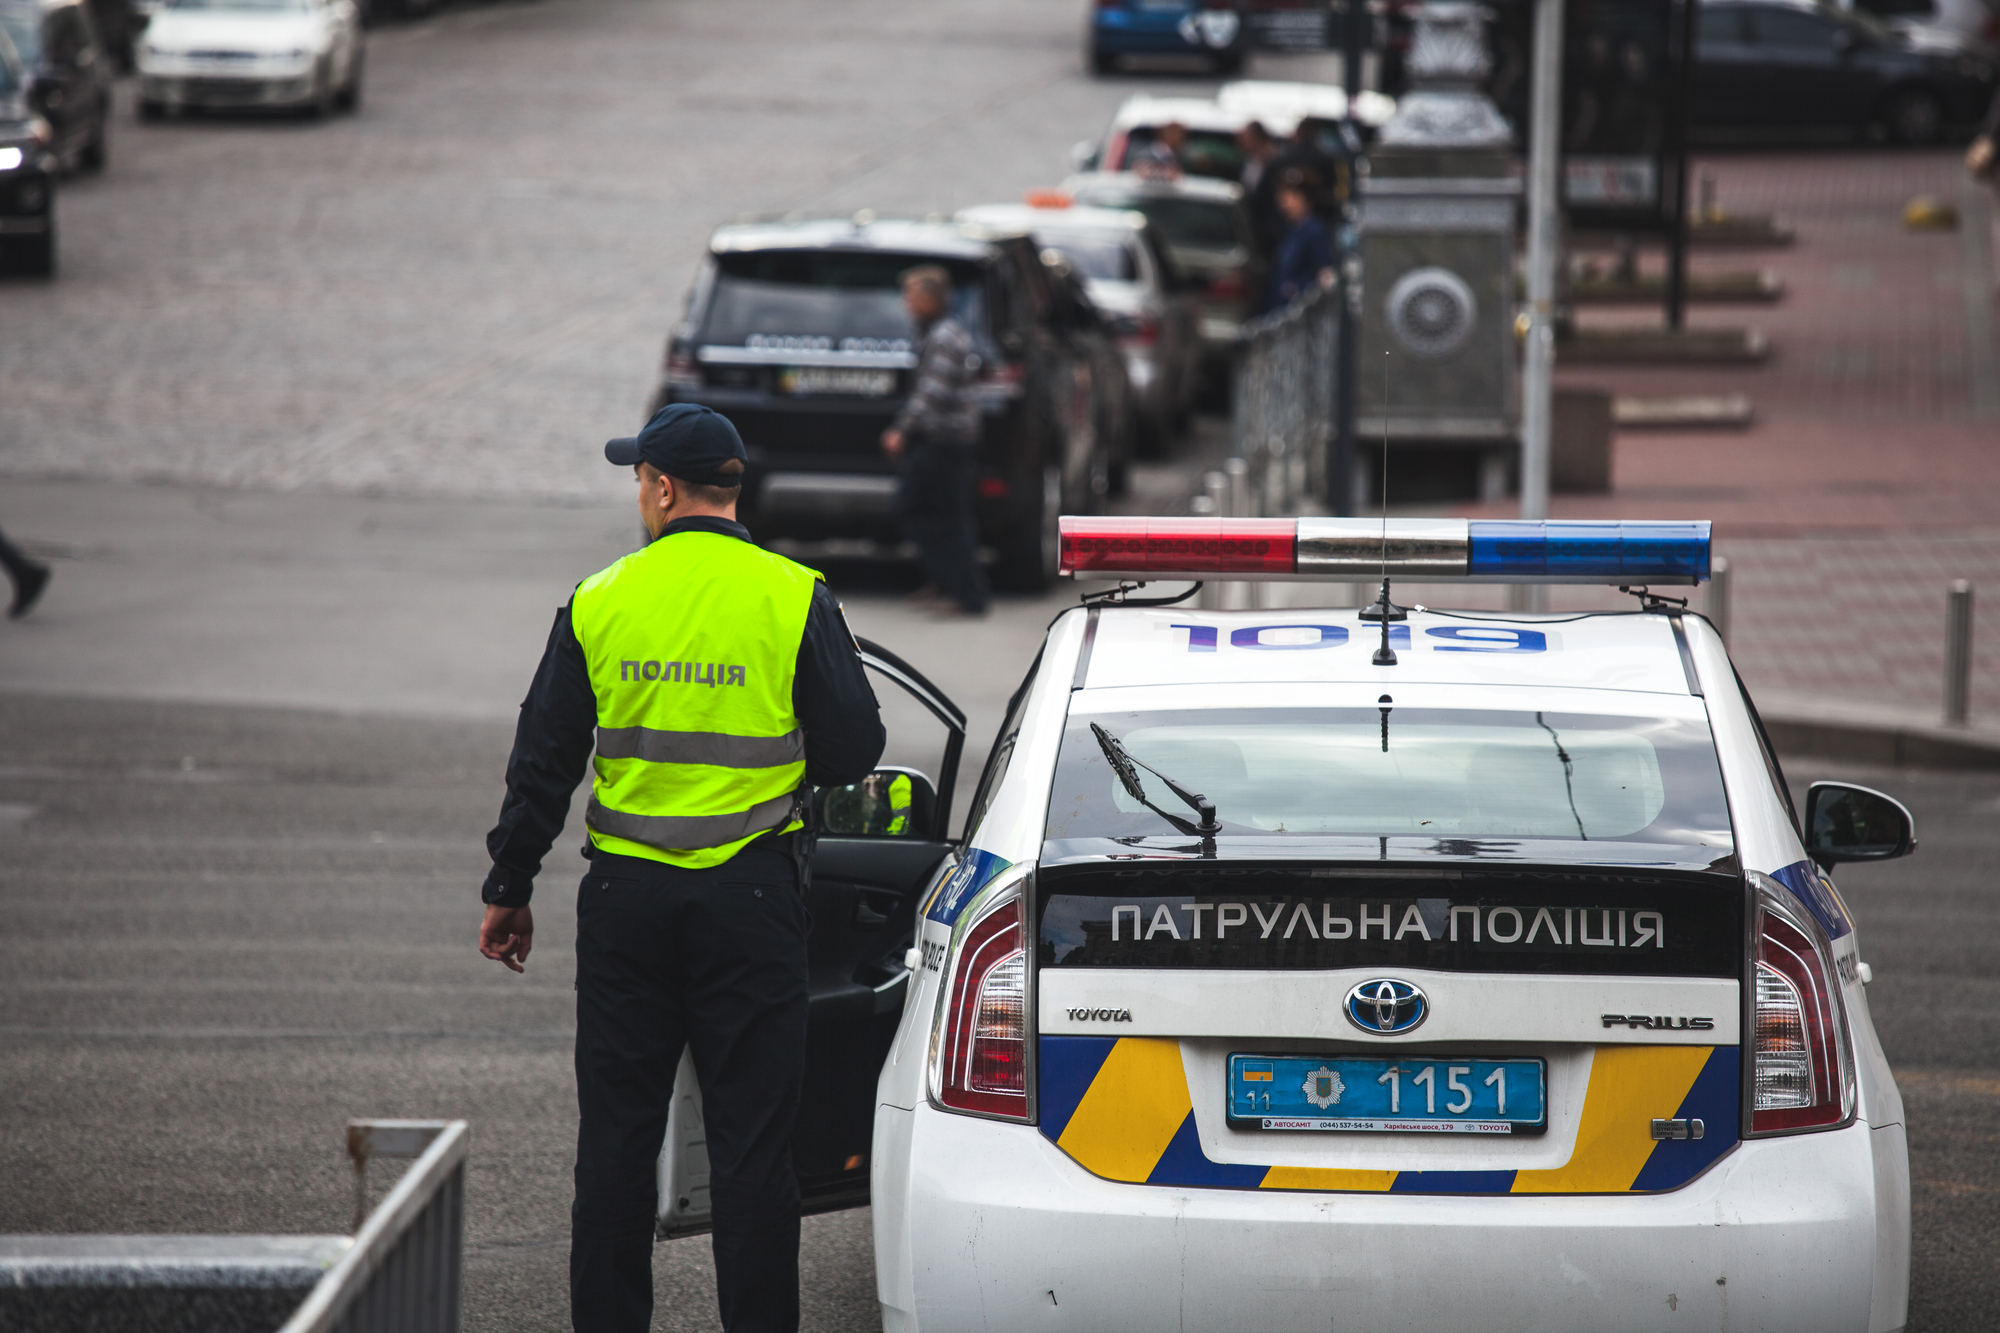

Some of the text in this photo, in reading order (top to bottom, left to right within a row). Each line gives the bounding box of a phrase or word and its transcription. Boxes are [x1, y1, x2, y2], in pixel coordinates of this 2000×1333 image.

[1169, 622, 1547, 653] 1019
[620, 660, 746, 689] ПОЛІЦІЯ
[1111, 902, 1665, 949] ПАТРУЛЬНА ПОЛІЦІЯ
[1066, 1007, 1133, 1022] TOYOTA
[1601, 1014, 1715, 1031] PRIUS
[1245, 1089, 1271, 1111] 11
[1376, 1065, 1507, 1115] 1151
[1478, 1124, 1510, 1132] TOYOTA
